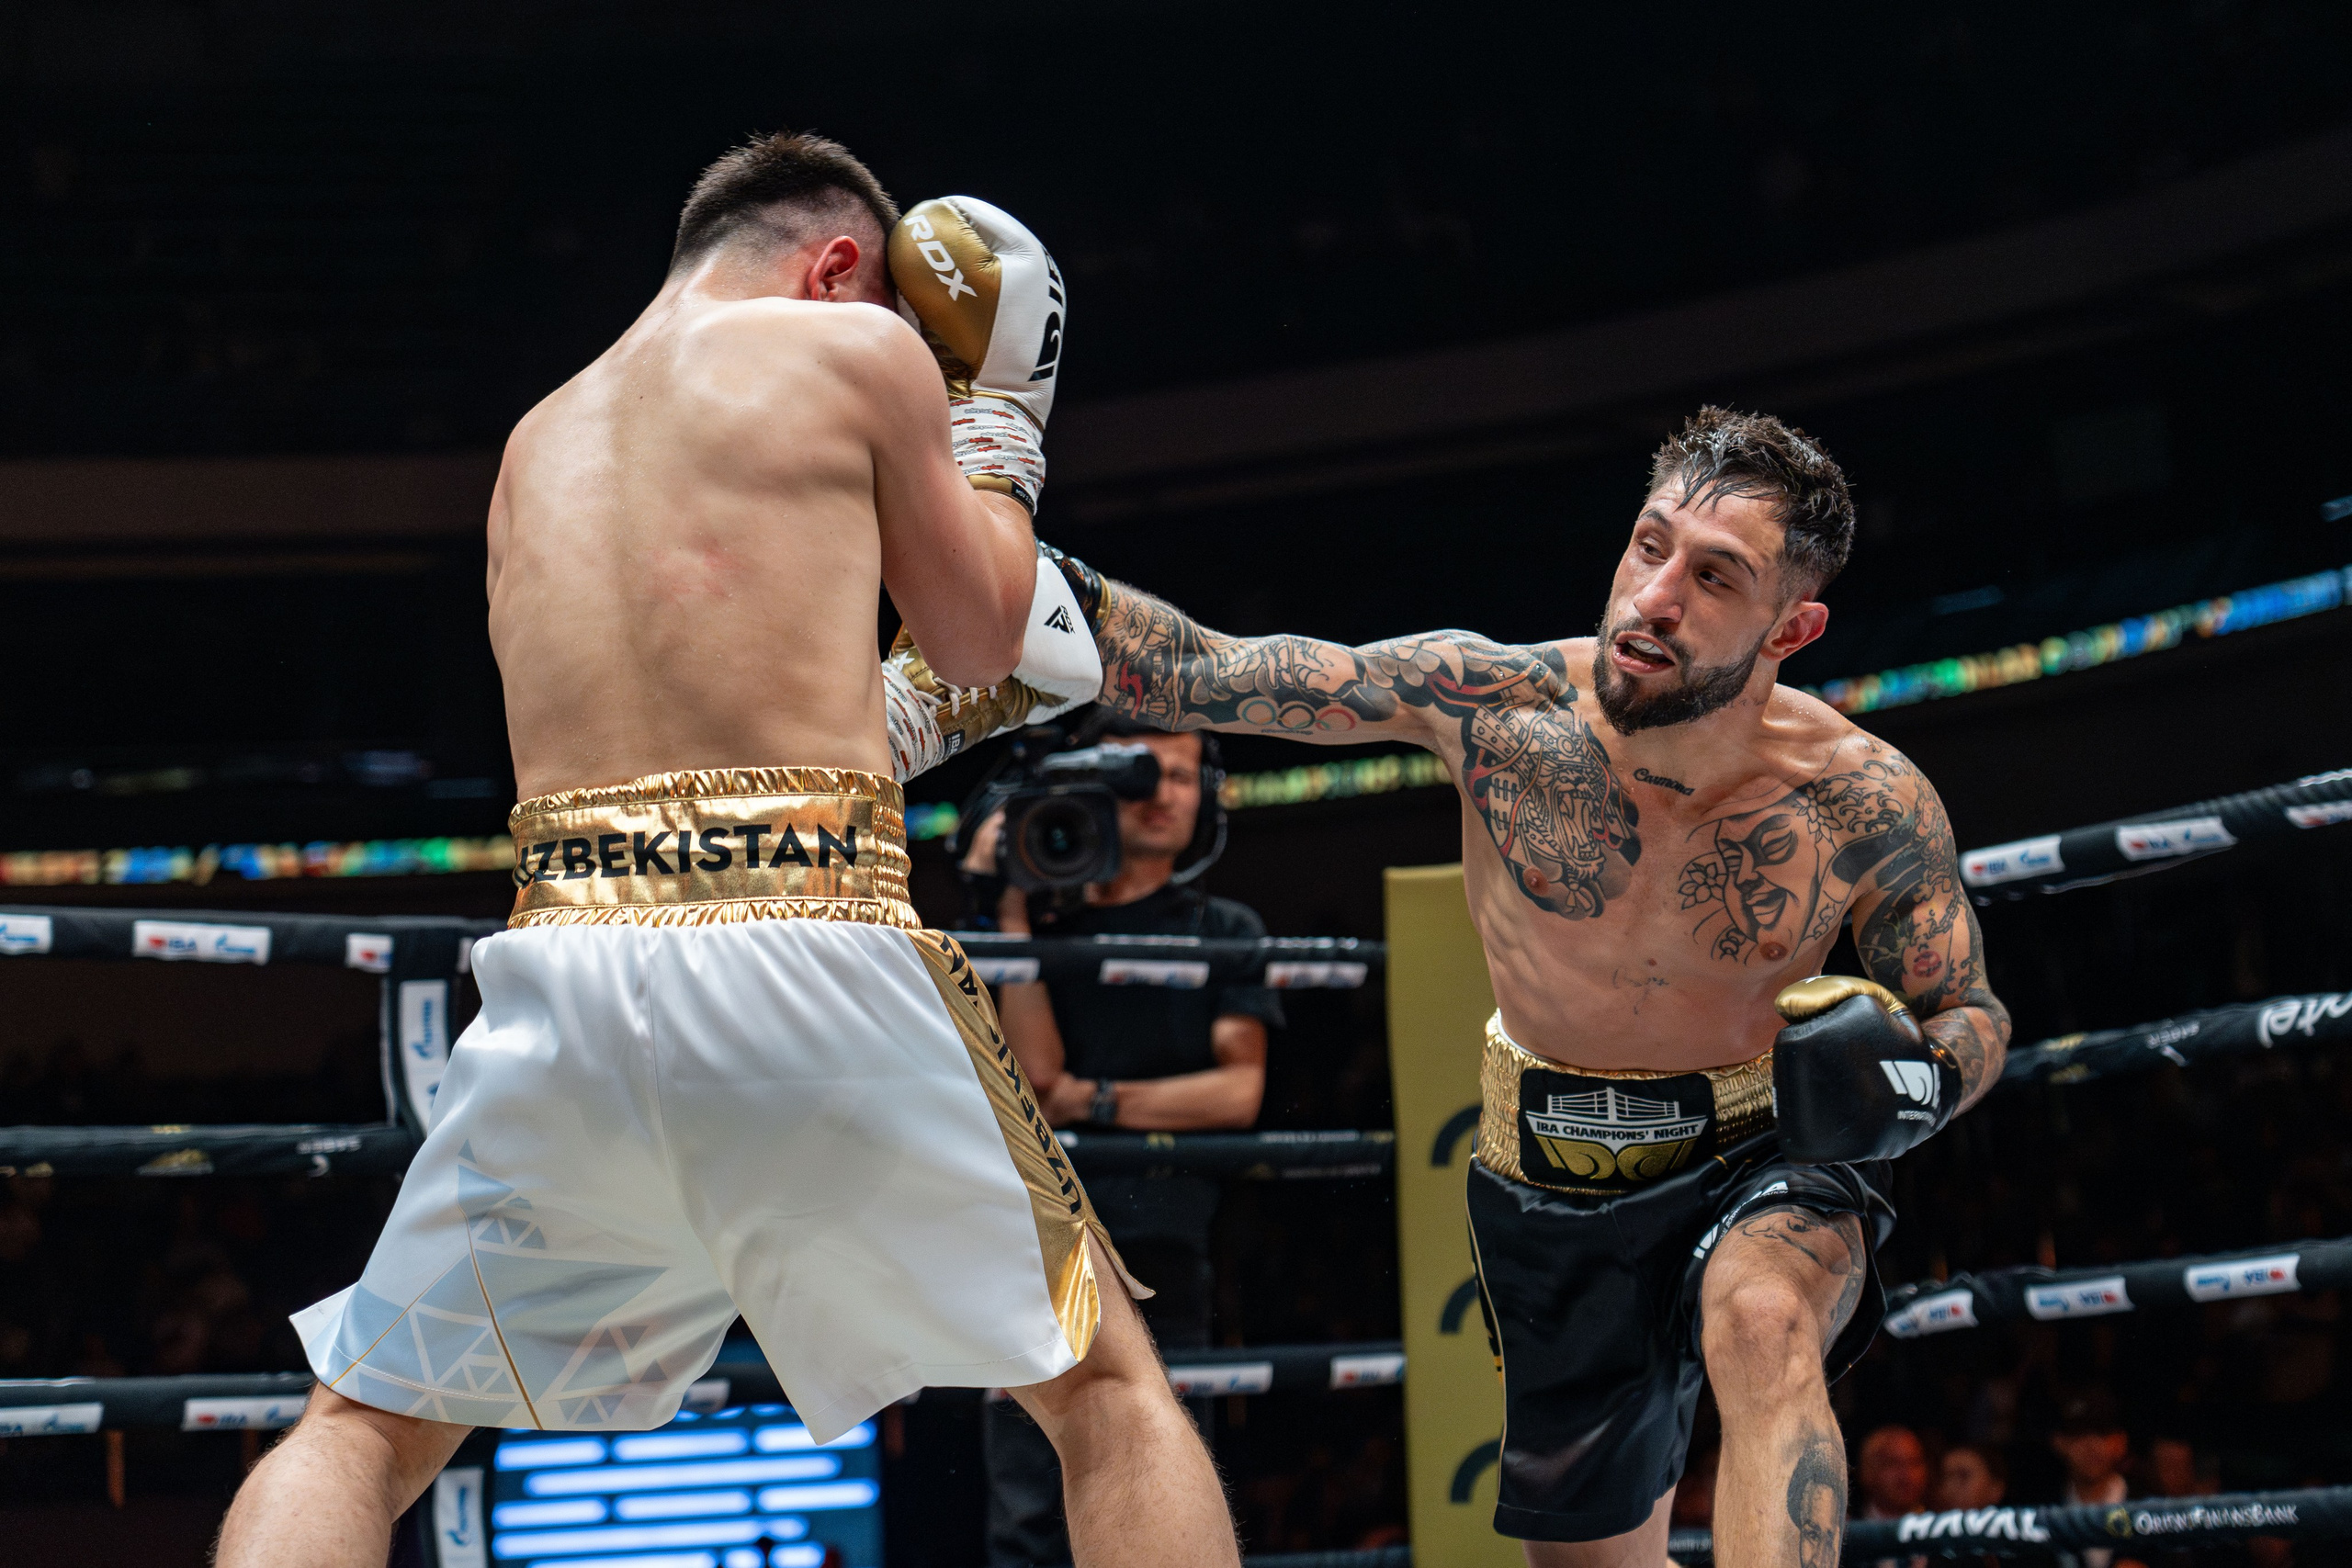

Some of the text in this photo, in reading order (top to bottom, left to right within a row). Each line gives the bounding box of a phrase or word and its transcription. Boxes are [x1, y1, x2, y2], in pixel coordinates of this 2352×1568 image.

[904, 214, 978, 301] RDX
[1061, 604, 1076, 635] RDX
[940, 933, 1082, 1215] UZBEKIAN
[1536, 1121, 1699, 1141] IBA CHAMPIONS' NIGHT
[1897, 1505, 2052, 1543] HAVAL
